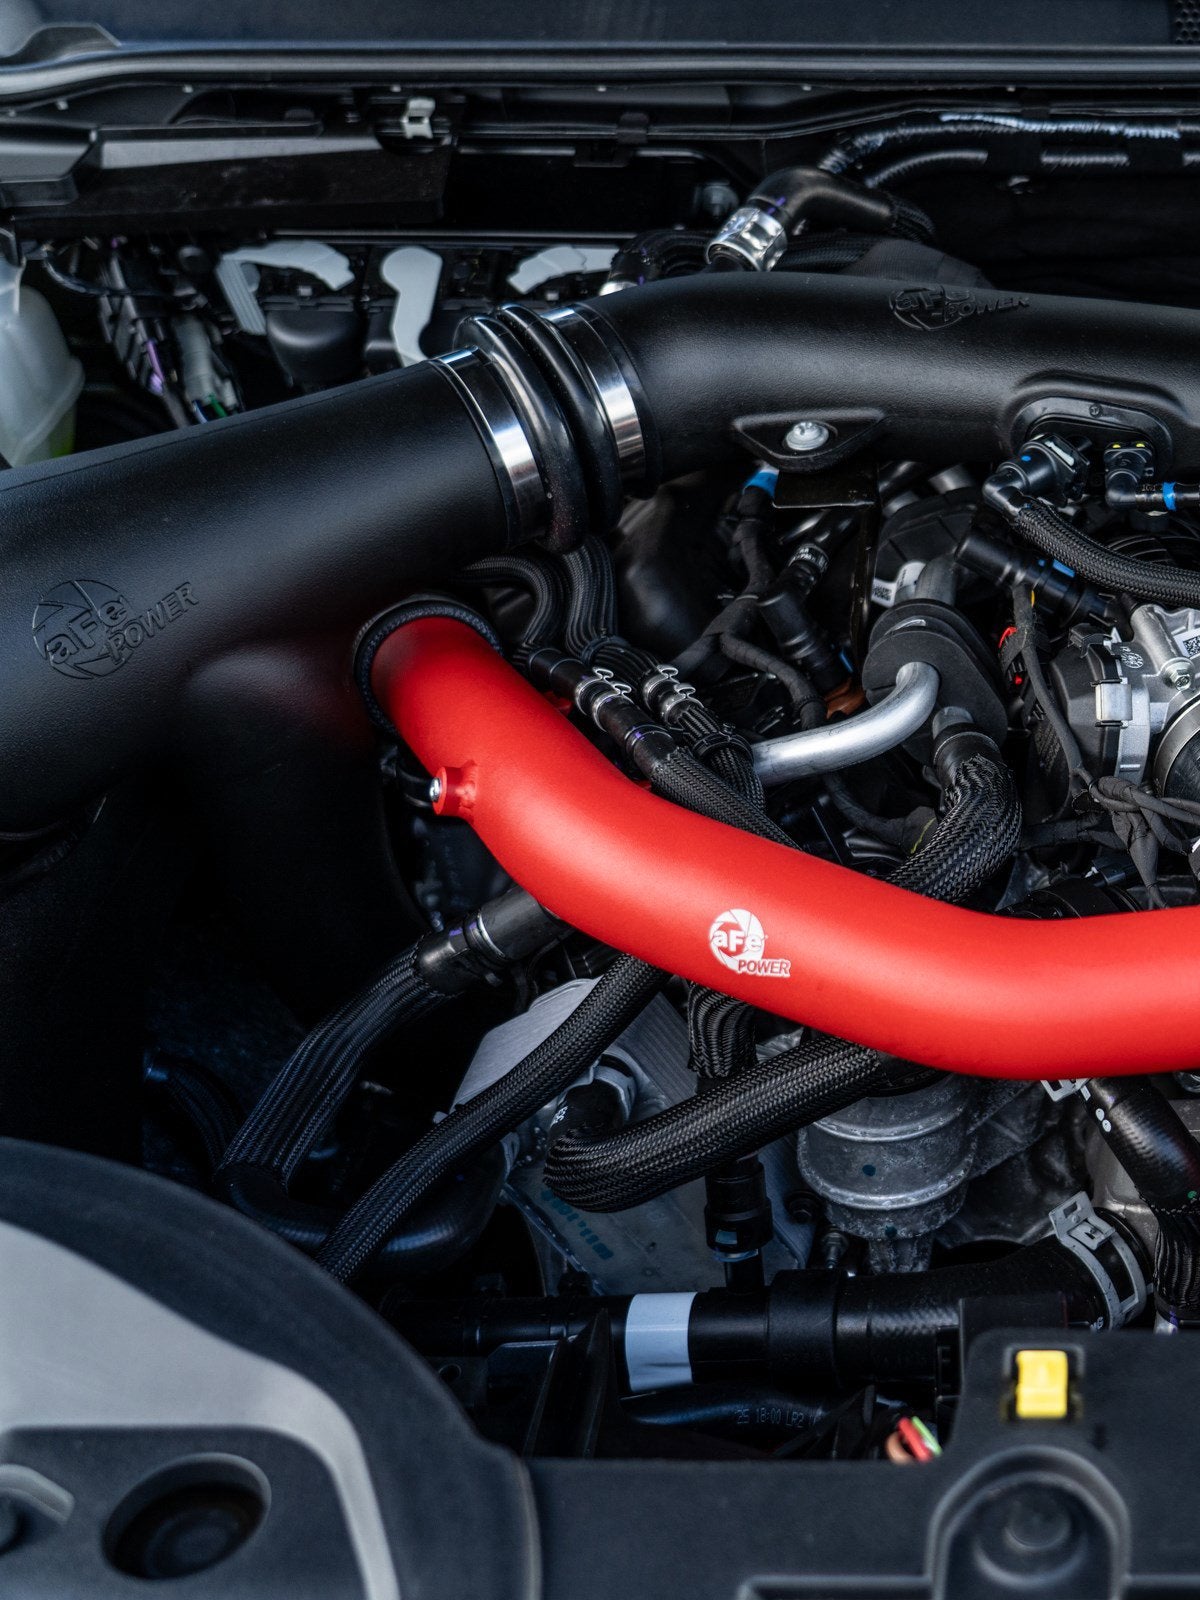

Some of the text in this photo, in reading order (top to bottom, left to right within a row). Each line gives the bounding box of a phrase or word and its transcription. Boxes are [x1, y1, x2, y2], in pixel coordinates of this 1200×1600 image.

[47, 599, 130, 665] aFe
[108, 581, 200, 665] POWER
[712, 926, 763, 953] aFe
[737, 959, 791, 977] POWER
